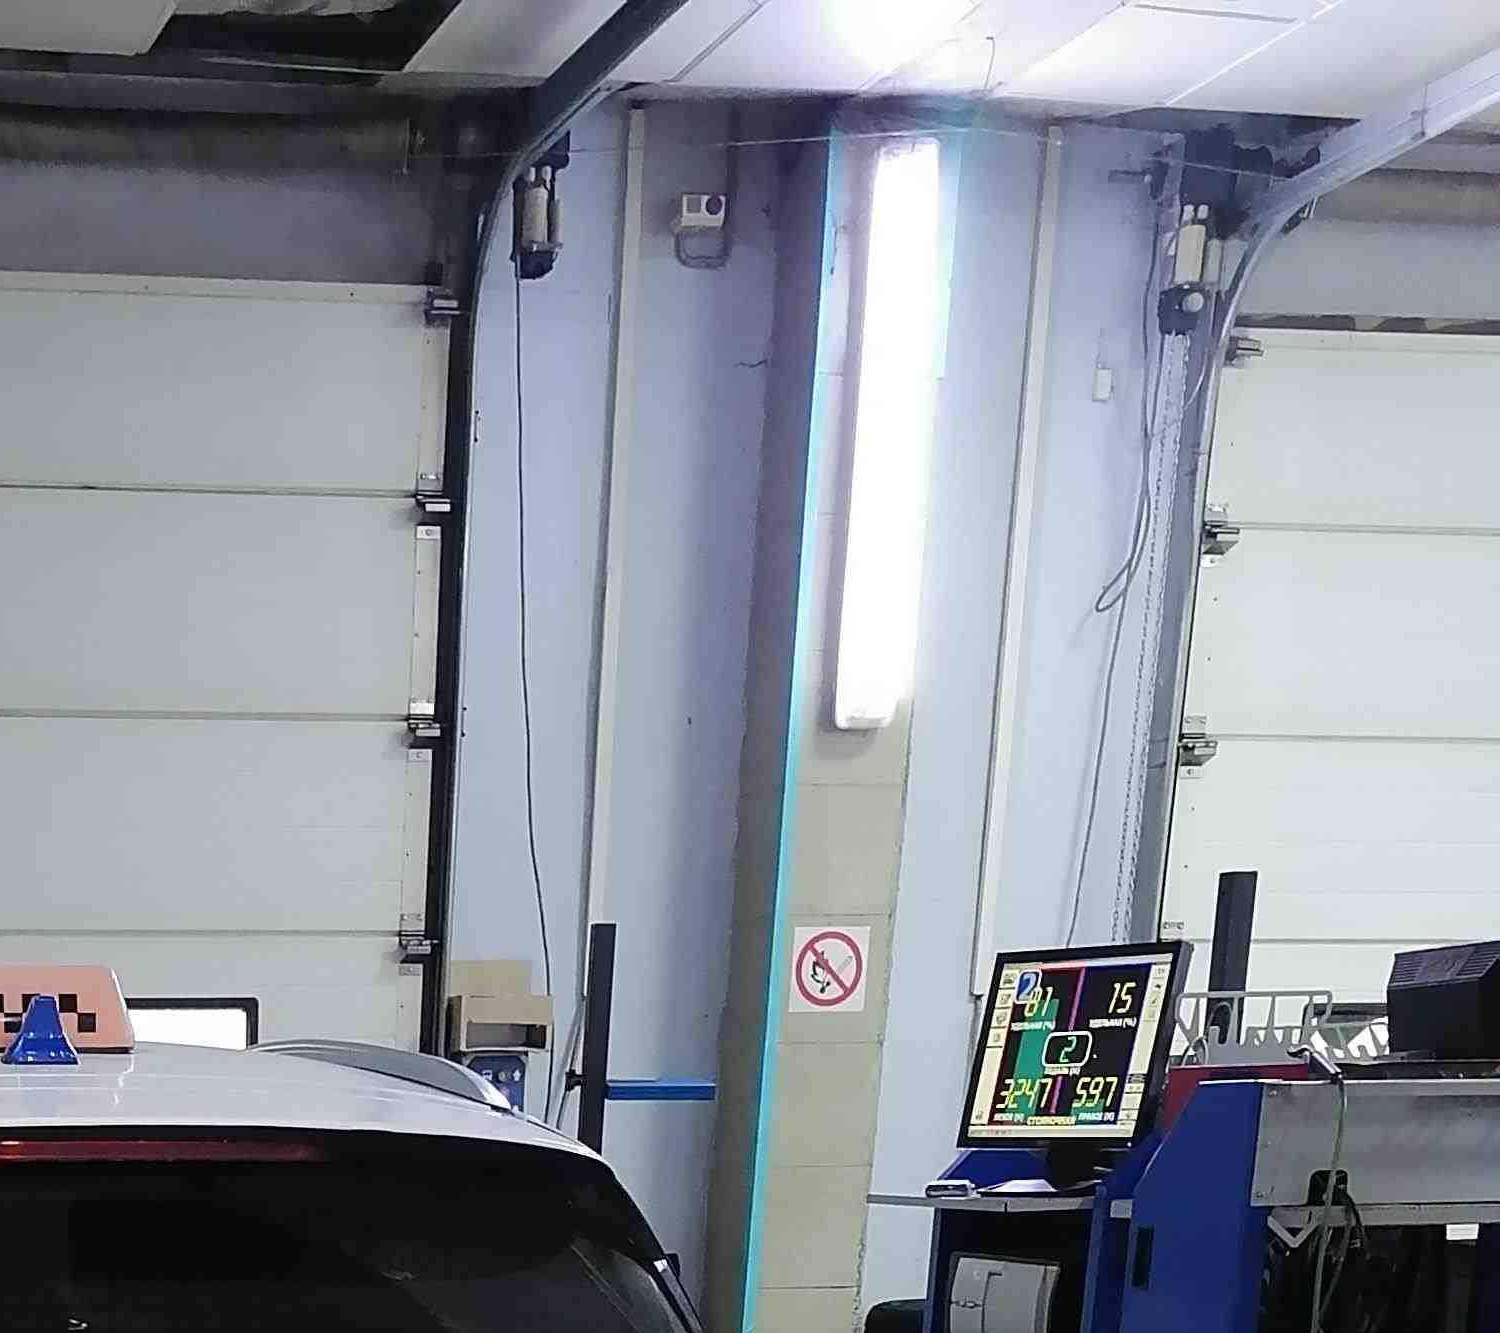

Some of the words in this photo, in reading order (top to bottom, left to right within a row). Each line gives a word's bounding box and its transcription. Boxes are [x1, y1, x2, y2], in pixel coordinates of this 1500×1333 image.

[1108, 982, 1135, 1014] 15
[1059, 1036, 1077, 1063] 2
[995, 1078, 1052, 1109] 3247
[1072, 1076, 1118, 1108] 597
